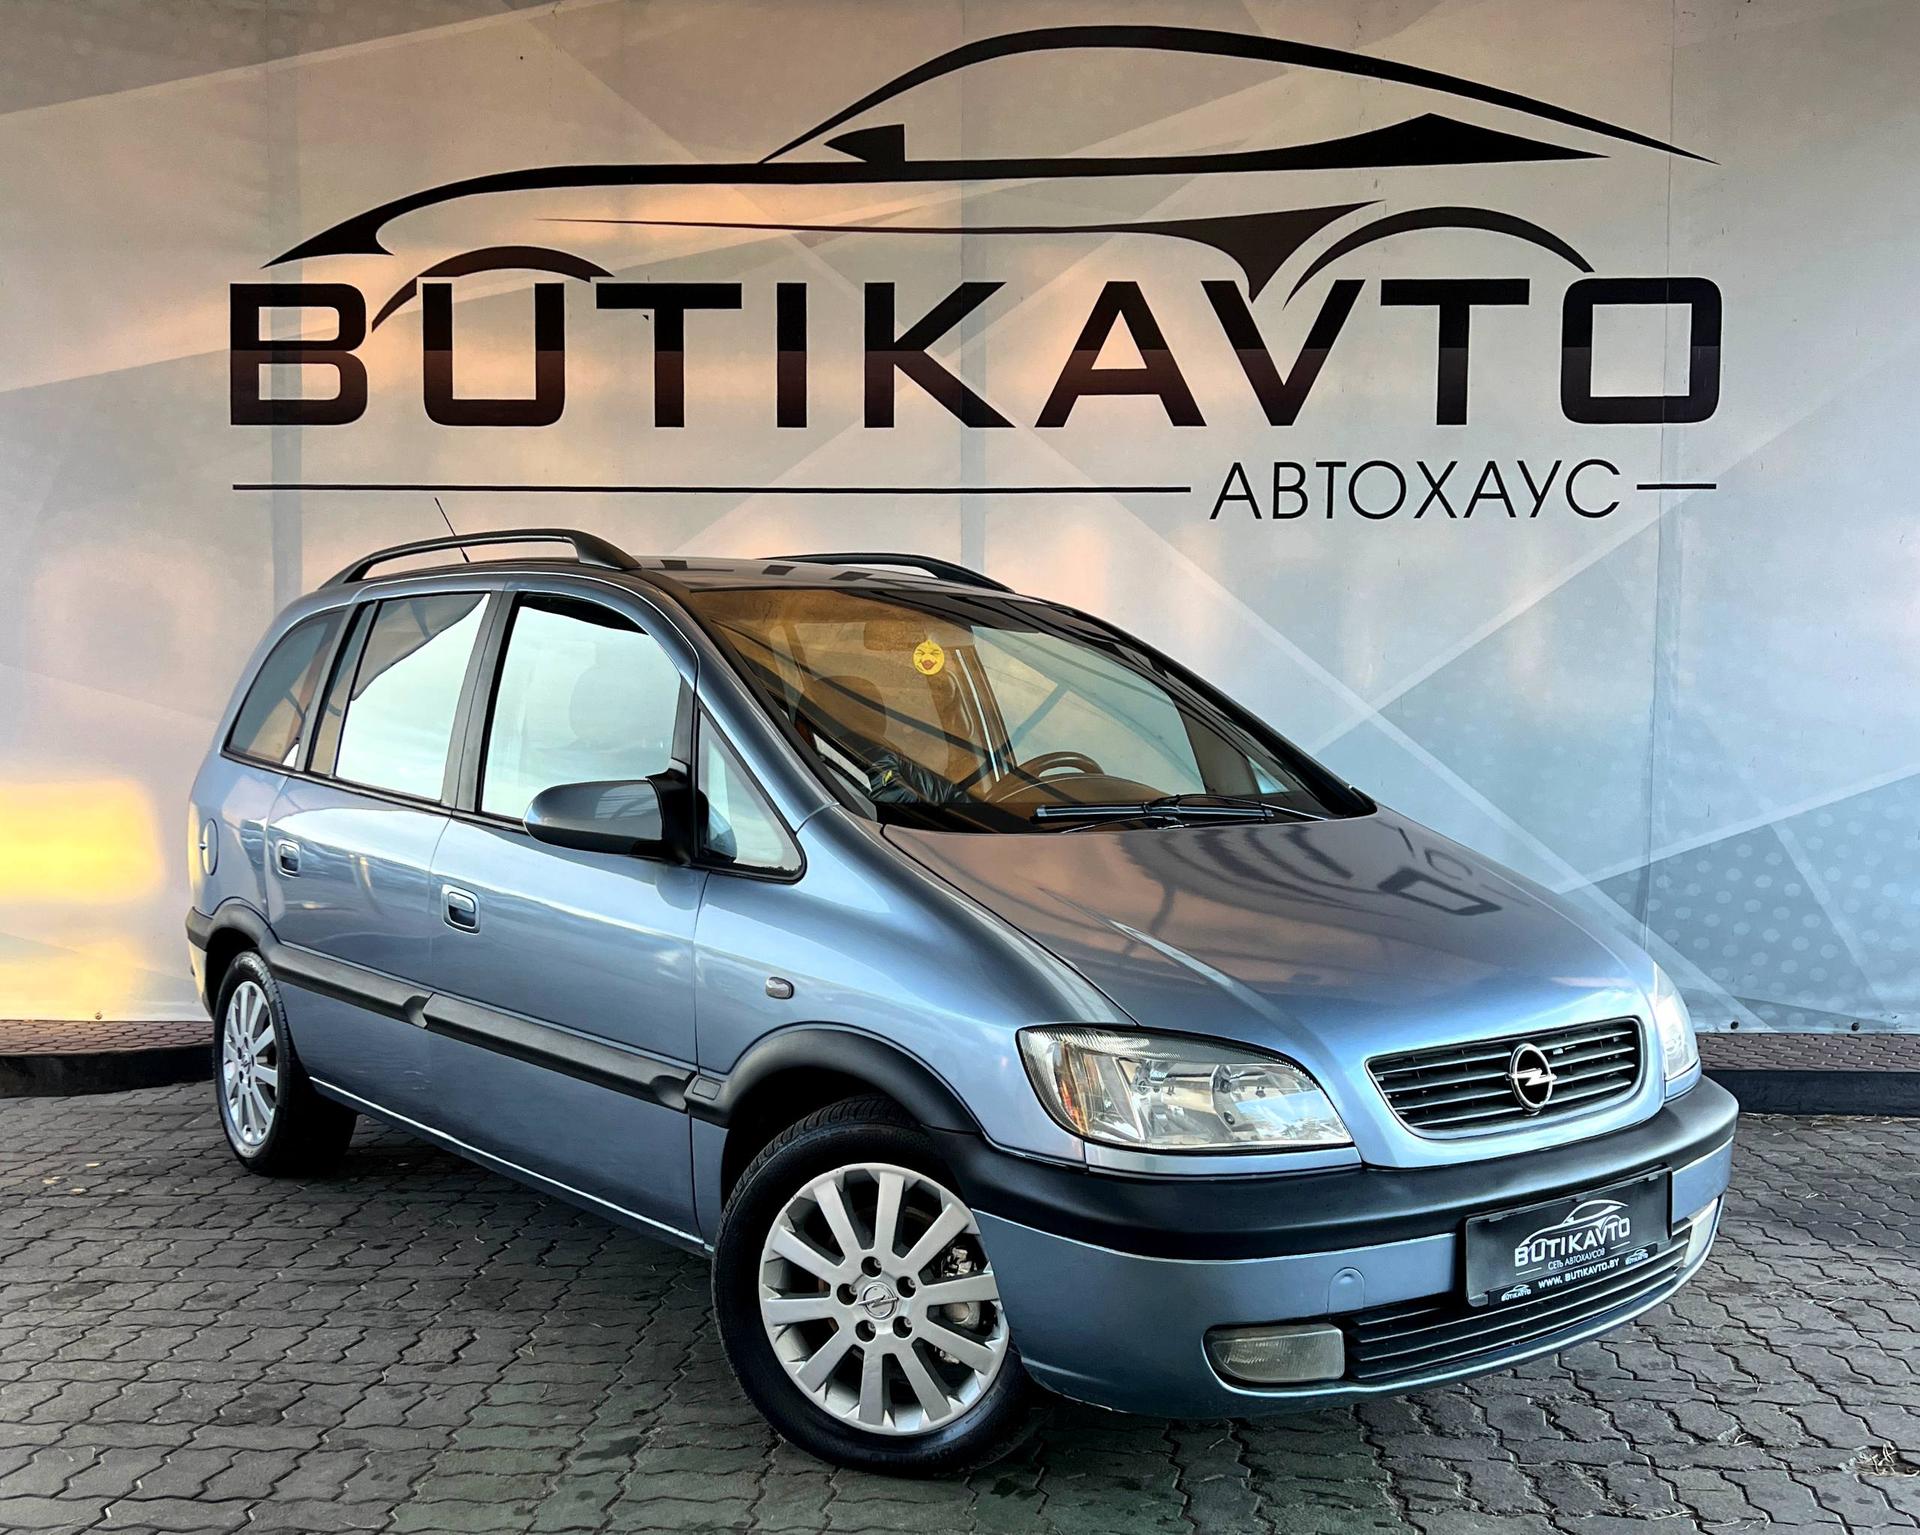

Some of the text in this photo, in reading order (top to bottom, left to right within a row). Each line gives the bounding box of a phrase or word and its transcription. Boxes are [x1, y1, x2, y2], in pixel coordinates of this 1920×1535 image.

[230, 278, 1722, 428] BUTIKAVTO
[1210, 460, 1620, 520] АВТОХАУС
[1515, 1217, 1631, 1267] BUTIKAVTO
